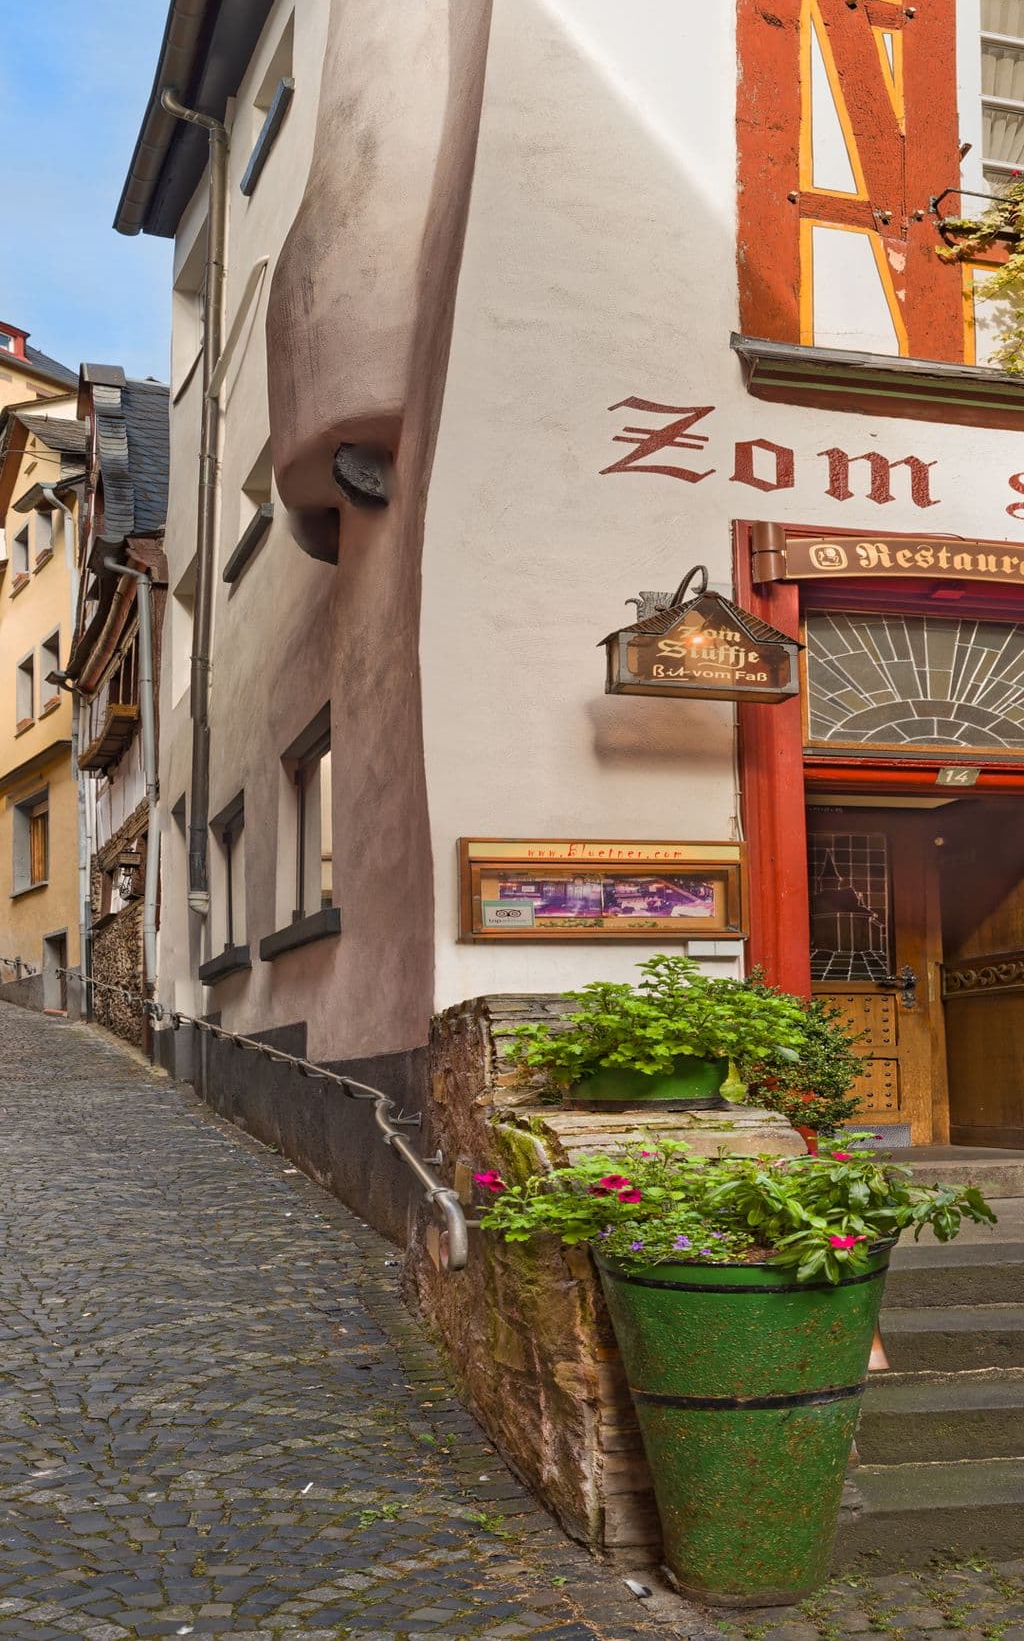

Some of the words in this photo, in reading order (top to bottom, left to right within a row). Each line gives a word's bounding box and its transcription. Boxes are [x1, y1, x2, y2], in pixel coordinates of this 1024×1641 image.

[599, 396, 941, 508] Zom
[652, 664, 690, 679] Bit
[691, 670, 731, 680] vom
[735, 671, 768, 682] Faß
[946, 770, 969, 783] 14
